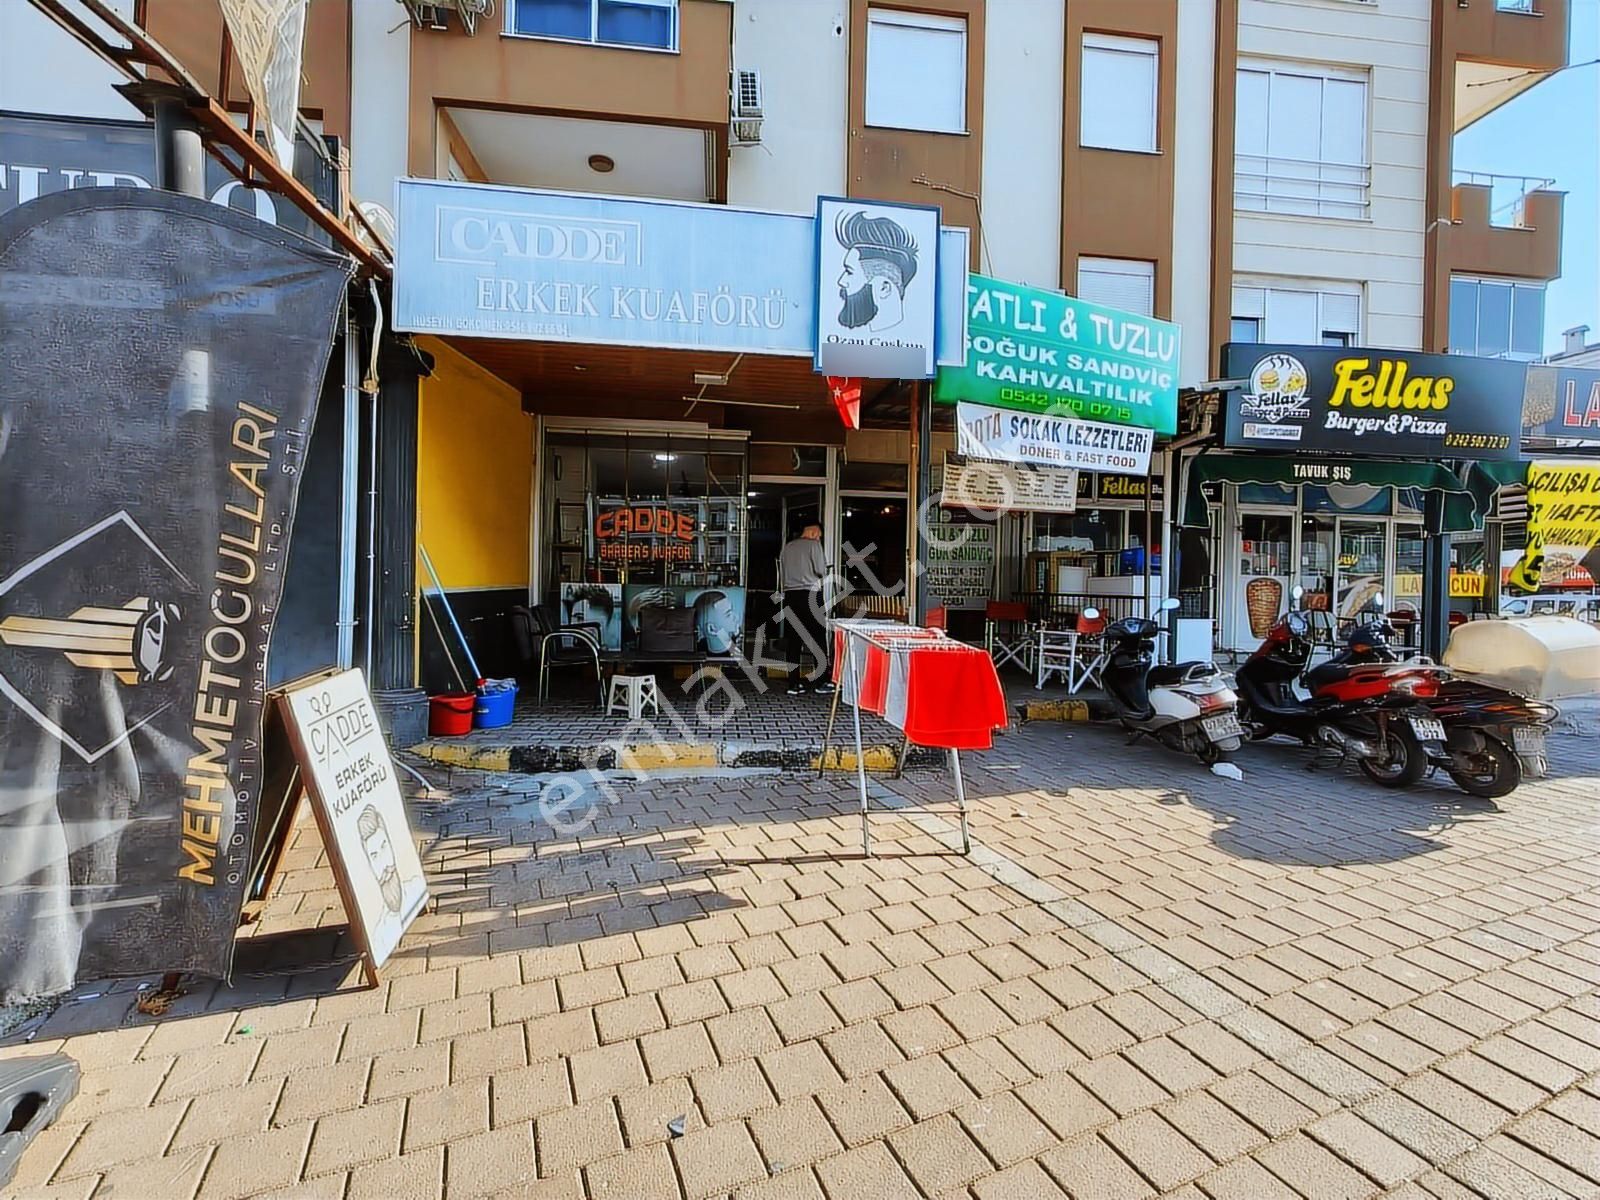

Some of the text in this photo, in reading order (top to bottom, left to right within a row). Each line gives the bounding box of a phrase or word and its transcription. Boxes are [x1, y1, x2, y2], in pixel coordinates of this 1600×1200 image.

[451, 217, 626, 265] CADDE
[476, 277, 599, 317] ERKEK
[610, 285, 787, 330] KUAFÖRÜ
[1059, 307, 1077, 341] &
[1089, 313, 1175, 361] TUZLU
[976, 360, 1153, 406] KAHVALTILIK
[1067, 354, 1173, 391] SANDVİÇ
[1328, 358, 1454, 410] Fellas
[1001, 388, 1048, 406] 0542
[1090, 402, 1112, 417] 07
[1116, 408, 1131, 419] 15
[1259, 392, 1297, 407] Fellas
[1010, 415, 1060, 444] SOKAK
[1066, 423, 1148, 453] LEZZETLERİ
[1324, 411, 1447, 436] Burger&Pizza
[1020, 443, 1060, 460] DÖNER
[1064, 450, 1072, 460] &
[1077, 451, 1101, 465] FAST
[1106, 455, 1136, 468] FOOD
[1294, 464, 1328, 478] TAVUK
[1102, 477, 1146, 495] Fellas
[265, 511, 286, 571] LTD.
[596, 507, 696, 543] CADDE
[311, 703, 373, 769] CADDE
[335, 752, 374, 789] ERKEK
[333, 763, 387, 818] KUAFÖRÜ
